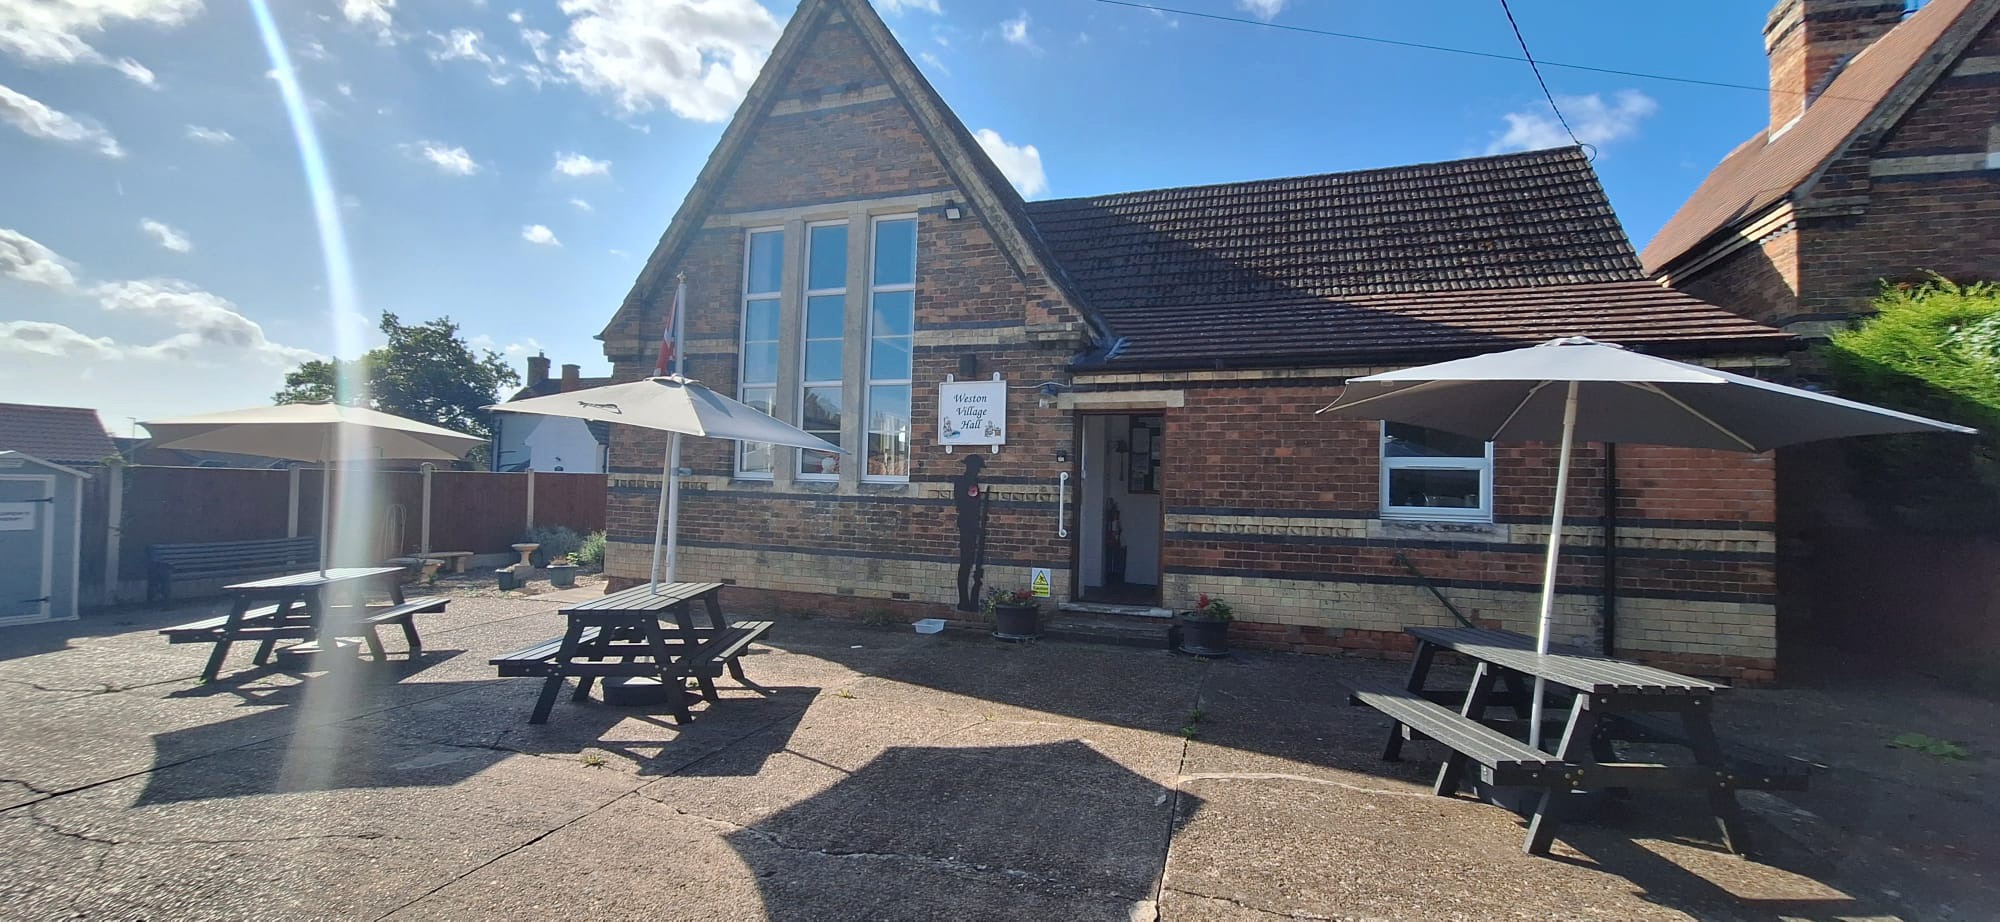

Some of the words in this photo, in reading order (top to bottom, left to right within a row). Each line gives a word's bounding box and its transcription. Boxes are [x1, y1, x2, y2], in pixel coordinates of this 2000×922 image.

[954, 393, 987, 403] Weston
[956, 405, 988, 418] Village
[961, 419, 983, 430] Hall
